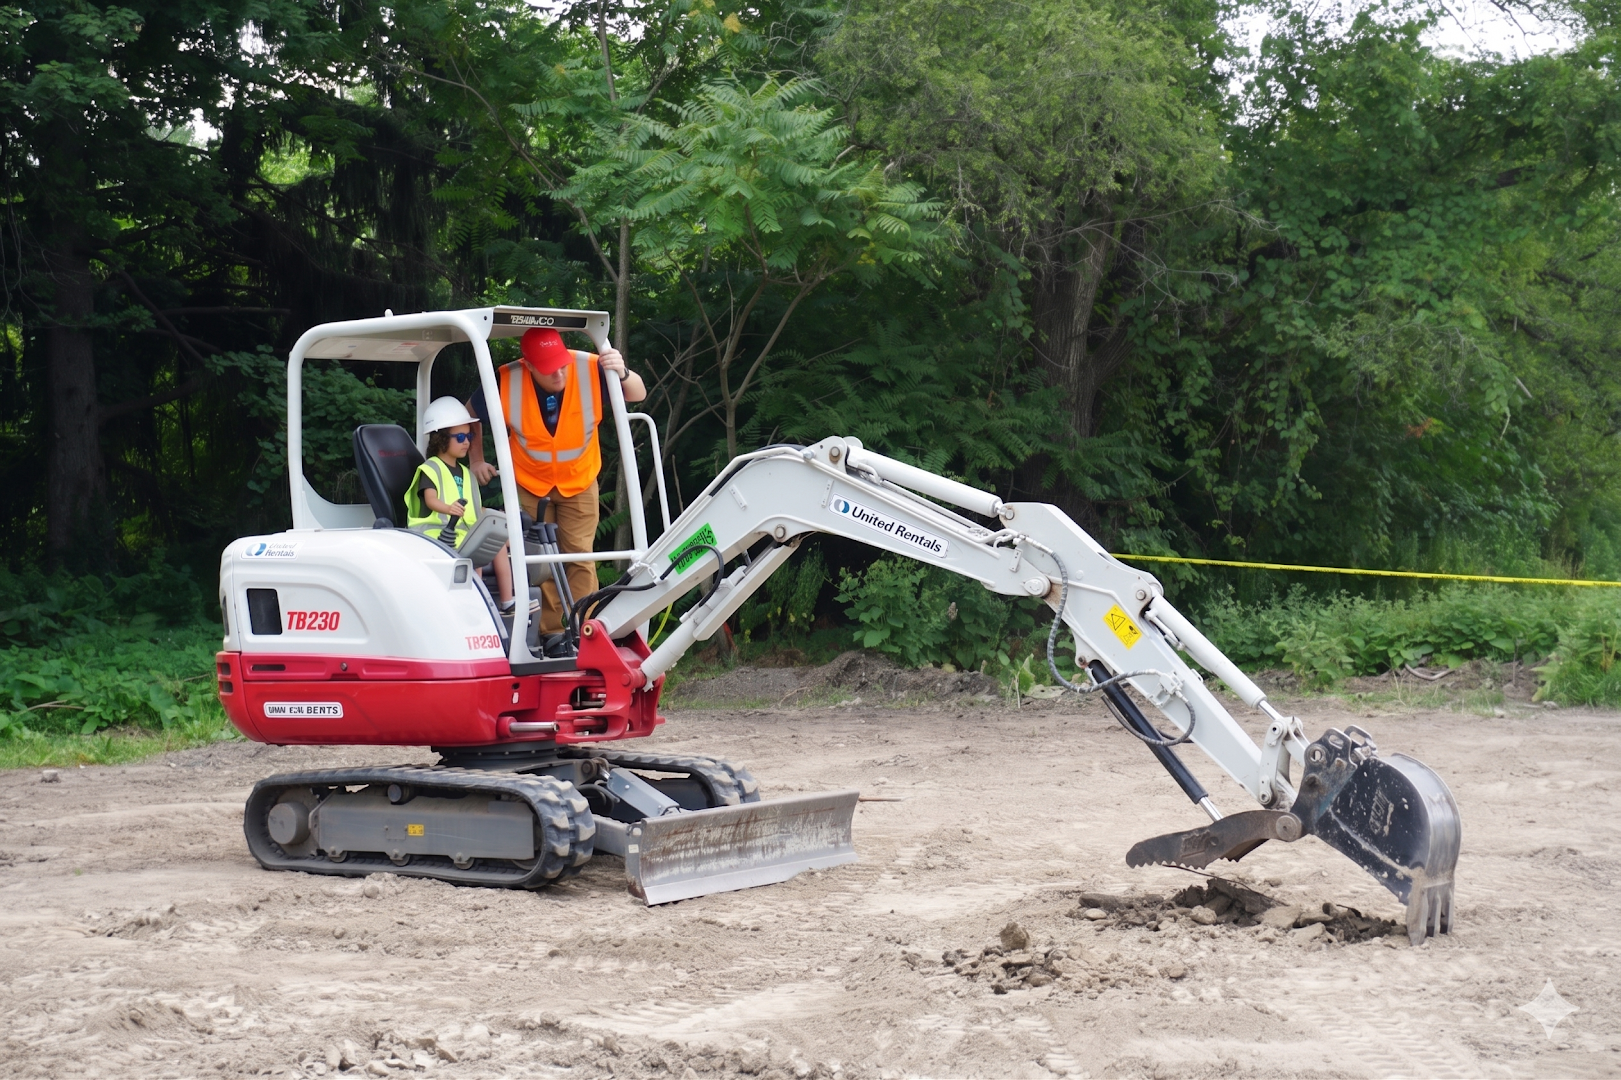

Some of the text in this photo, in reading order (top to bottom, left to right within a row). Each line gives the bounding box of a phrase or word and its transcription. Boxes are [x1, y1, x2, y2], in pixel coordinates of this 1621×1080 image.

[851, 506, 942, 553] United Rentals
[286, 611, 341, 631] TB230
[464, 634, 501, 651] TB230
